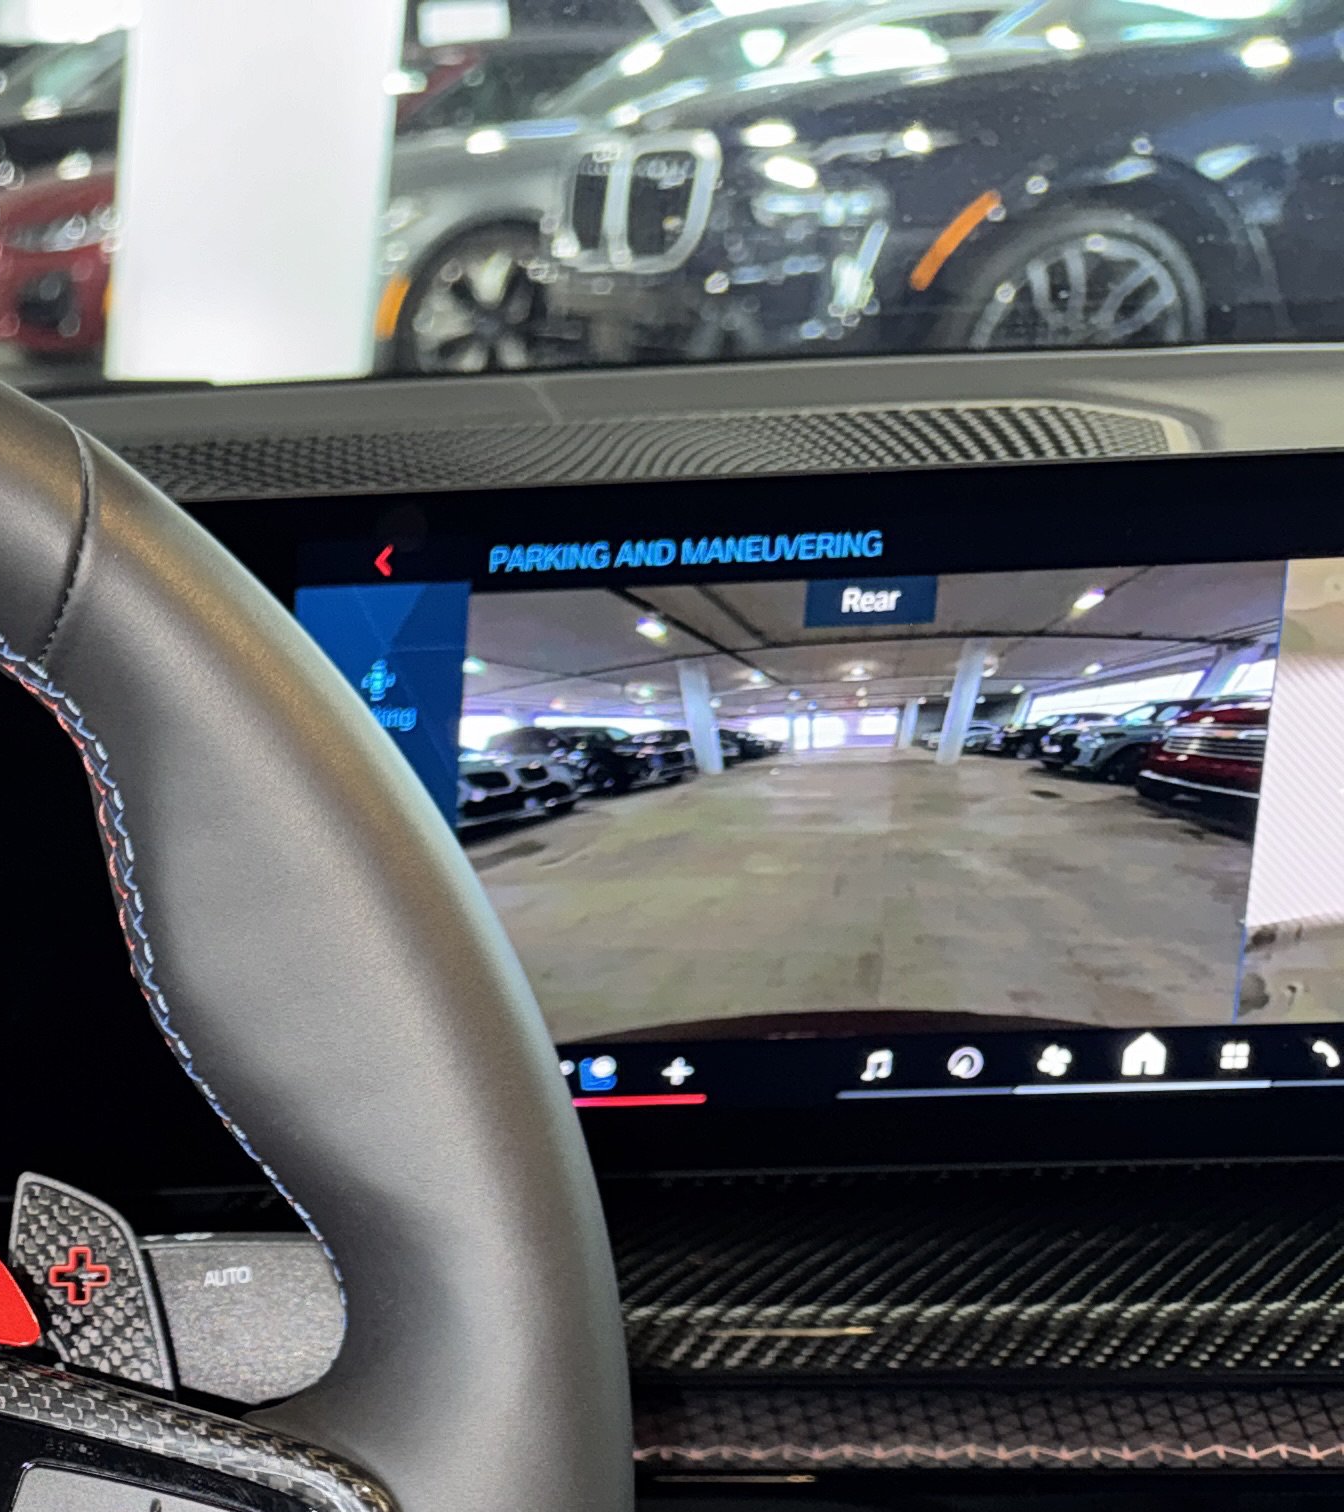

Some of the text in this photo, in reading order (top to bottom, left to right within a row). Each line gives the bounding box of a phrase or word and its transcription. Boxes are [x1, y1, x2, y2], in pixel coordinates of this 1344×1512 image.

[489, 530, 884, 573] PARKING AND MANEUVERING
[841, 587, 902, 614] Rear
[204, 1266, 252, 1288] AUTO
